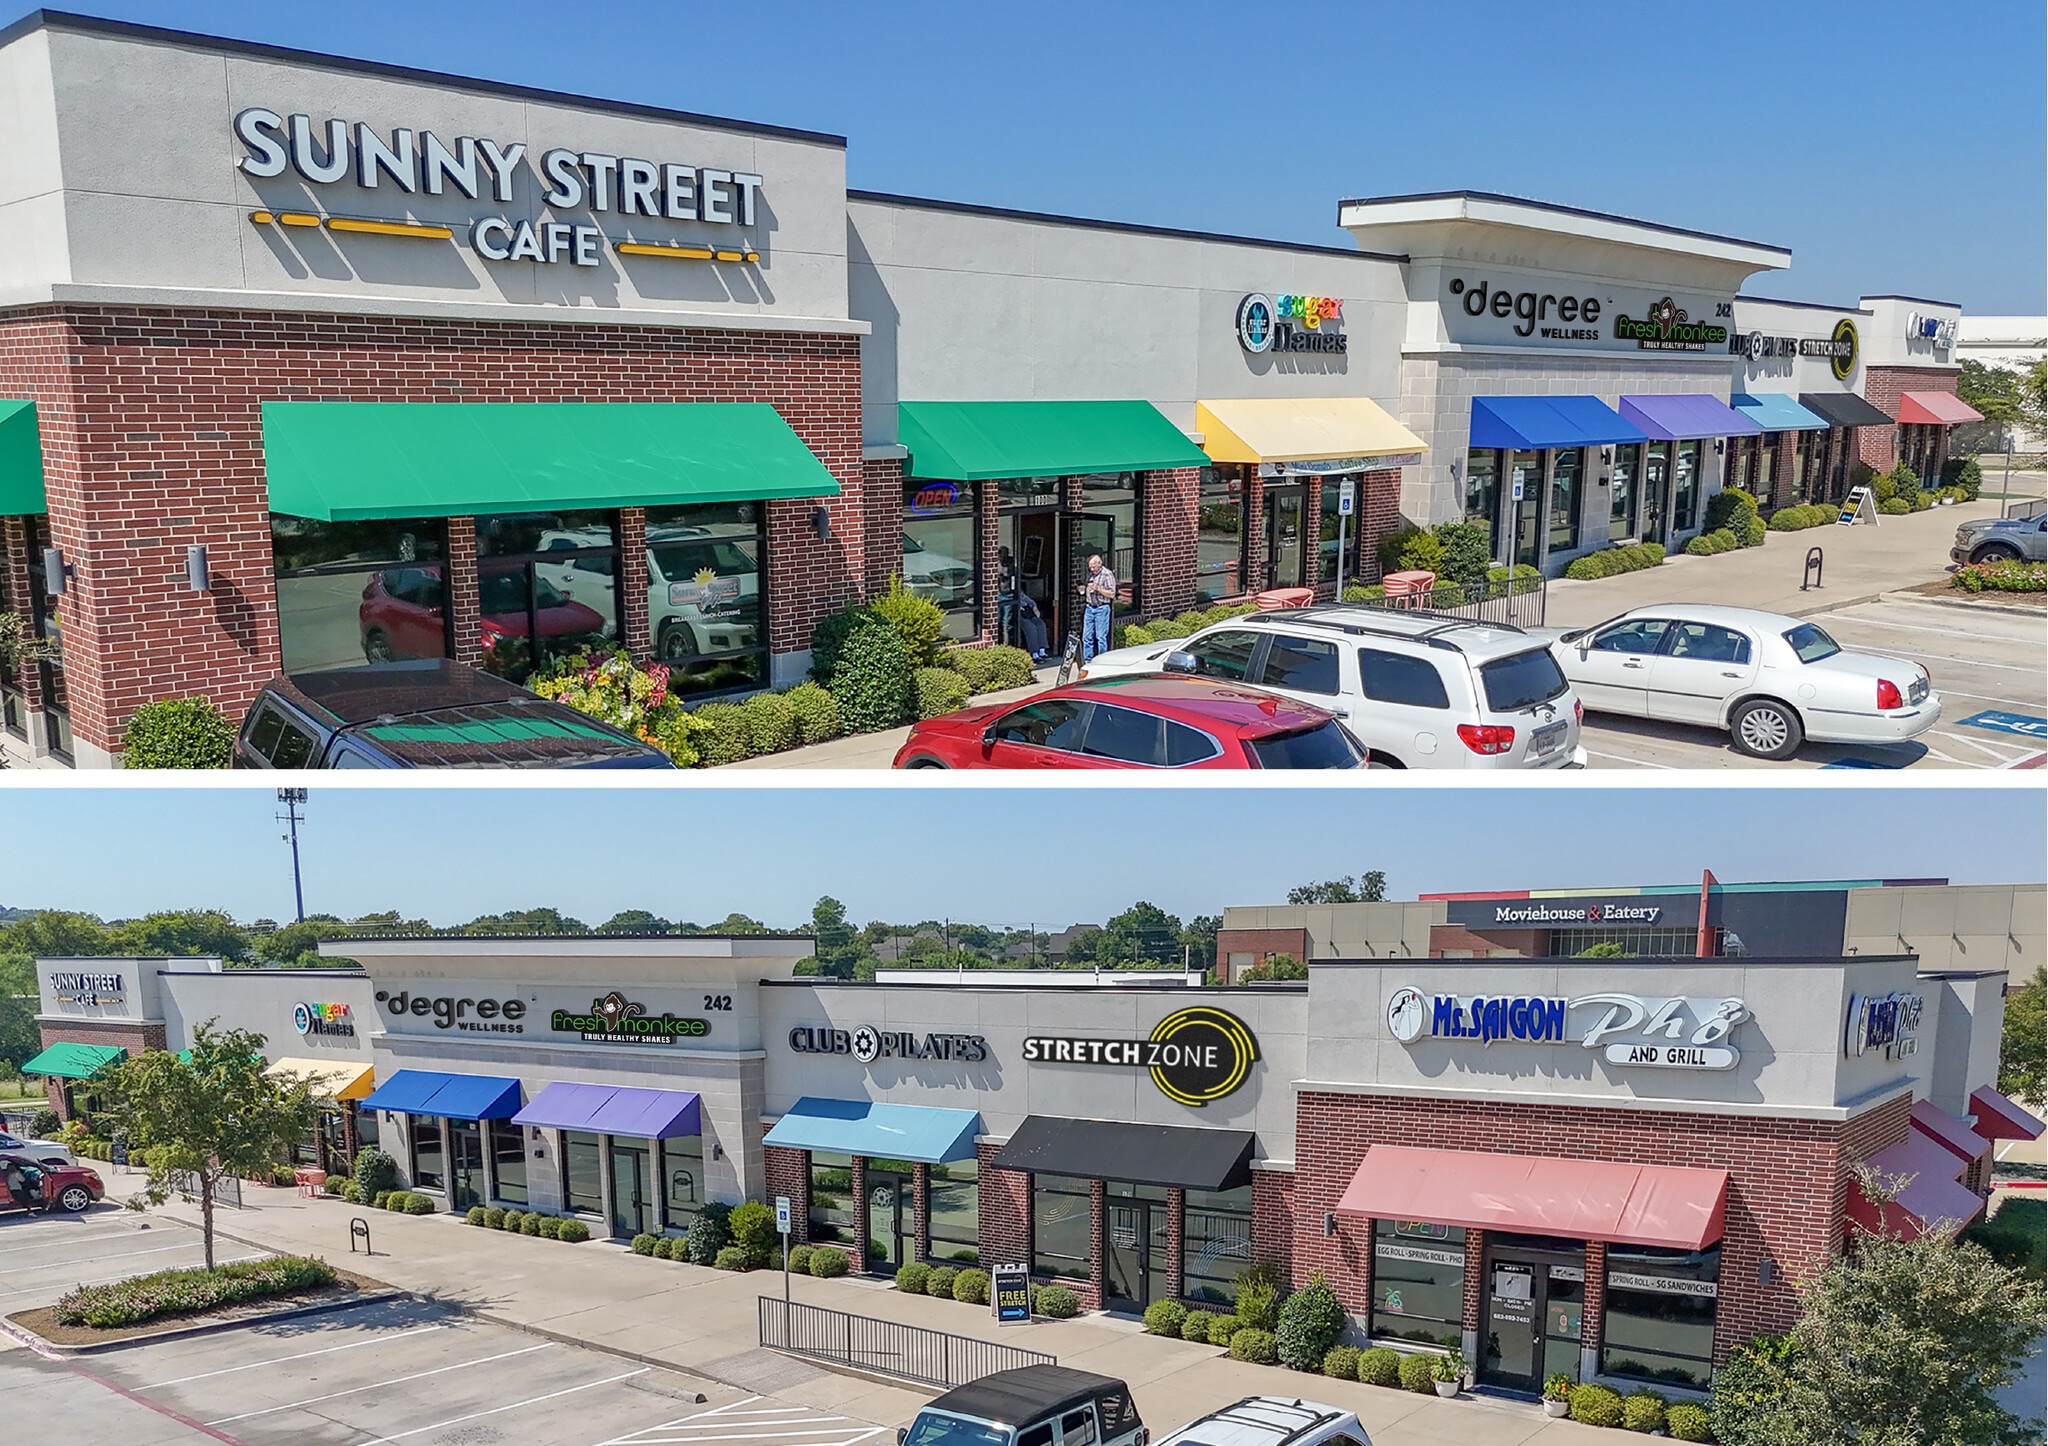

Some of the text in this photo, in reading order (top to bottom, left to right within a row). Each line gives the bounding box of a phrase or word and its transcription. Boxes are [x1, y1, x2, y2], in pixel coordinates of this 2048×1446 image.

[236, 107, 764, 227] SUNNY STREET
[471, 216, 600, 267] CAFE
[1277, 294, 1344, 329] sugar
[1715, 303, 1731, 317] 242
[1618, 306, 1726, 342] fresh monkee
[1540, 327, 1599, 341] WELLNESS
[1643, 341, 1705, 350] TRULY HEALTHY SHAKES
[1762, 336, 1798, 358] PILATES
[1802, 340, 1851, 357] STRETCH ZONE
[915, 488, 952, 507] OPEN
[1495, 904, 1660, 922] Moviehouse & Eatery
[49, 973, 119, 991] SUNNY STREET
[75, 994, 96, 1007] CAFE
[703, 995, 733, 1011] 242
[312, 1003, 350, 1022] sugar
[552, 1000, 706, 1036] fresh monkee
[457, 1022, 525, 1034] WELLNESS
[584, 1033, 671, 1044] TRULY HEALTHY SHAKES
[789, 1027, 987, 1063] CLUB PILATES
[1024, 1037, 1218, 1068] STRETCH ZONE
[1628, 1046, 1707, 1066] AND GRILL
[1378, 1246, 1390, 1255] EGG
[1390, 1247, 1405, 1257] ROLL
[1408, 1249, 1430, 1260] SPRING
[1431, 1252, 1446, 1261] ROLL
[1449, 1255, 1463, 1264] PHO
[1612, 1274, 1634, 1285] SPRING
[1634, 1277, 1650, 1287] ROLL
[1656, 1279, 1667, 1289] SG
[1667, 1280, 1714, 1294] SANDWICHES
[1000, 1290, 1026, 1301] FREE
